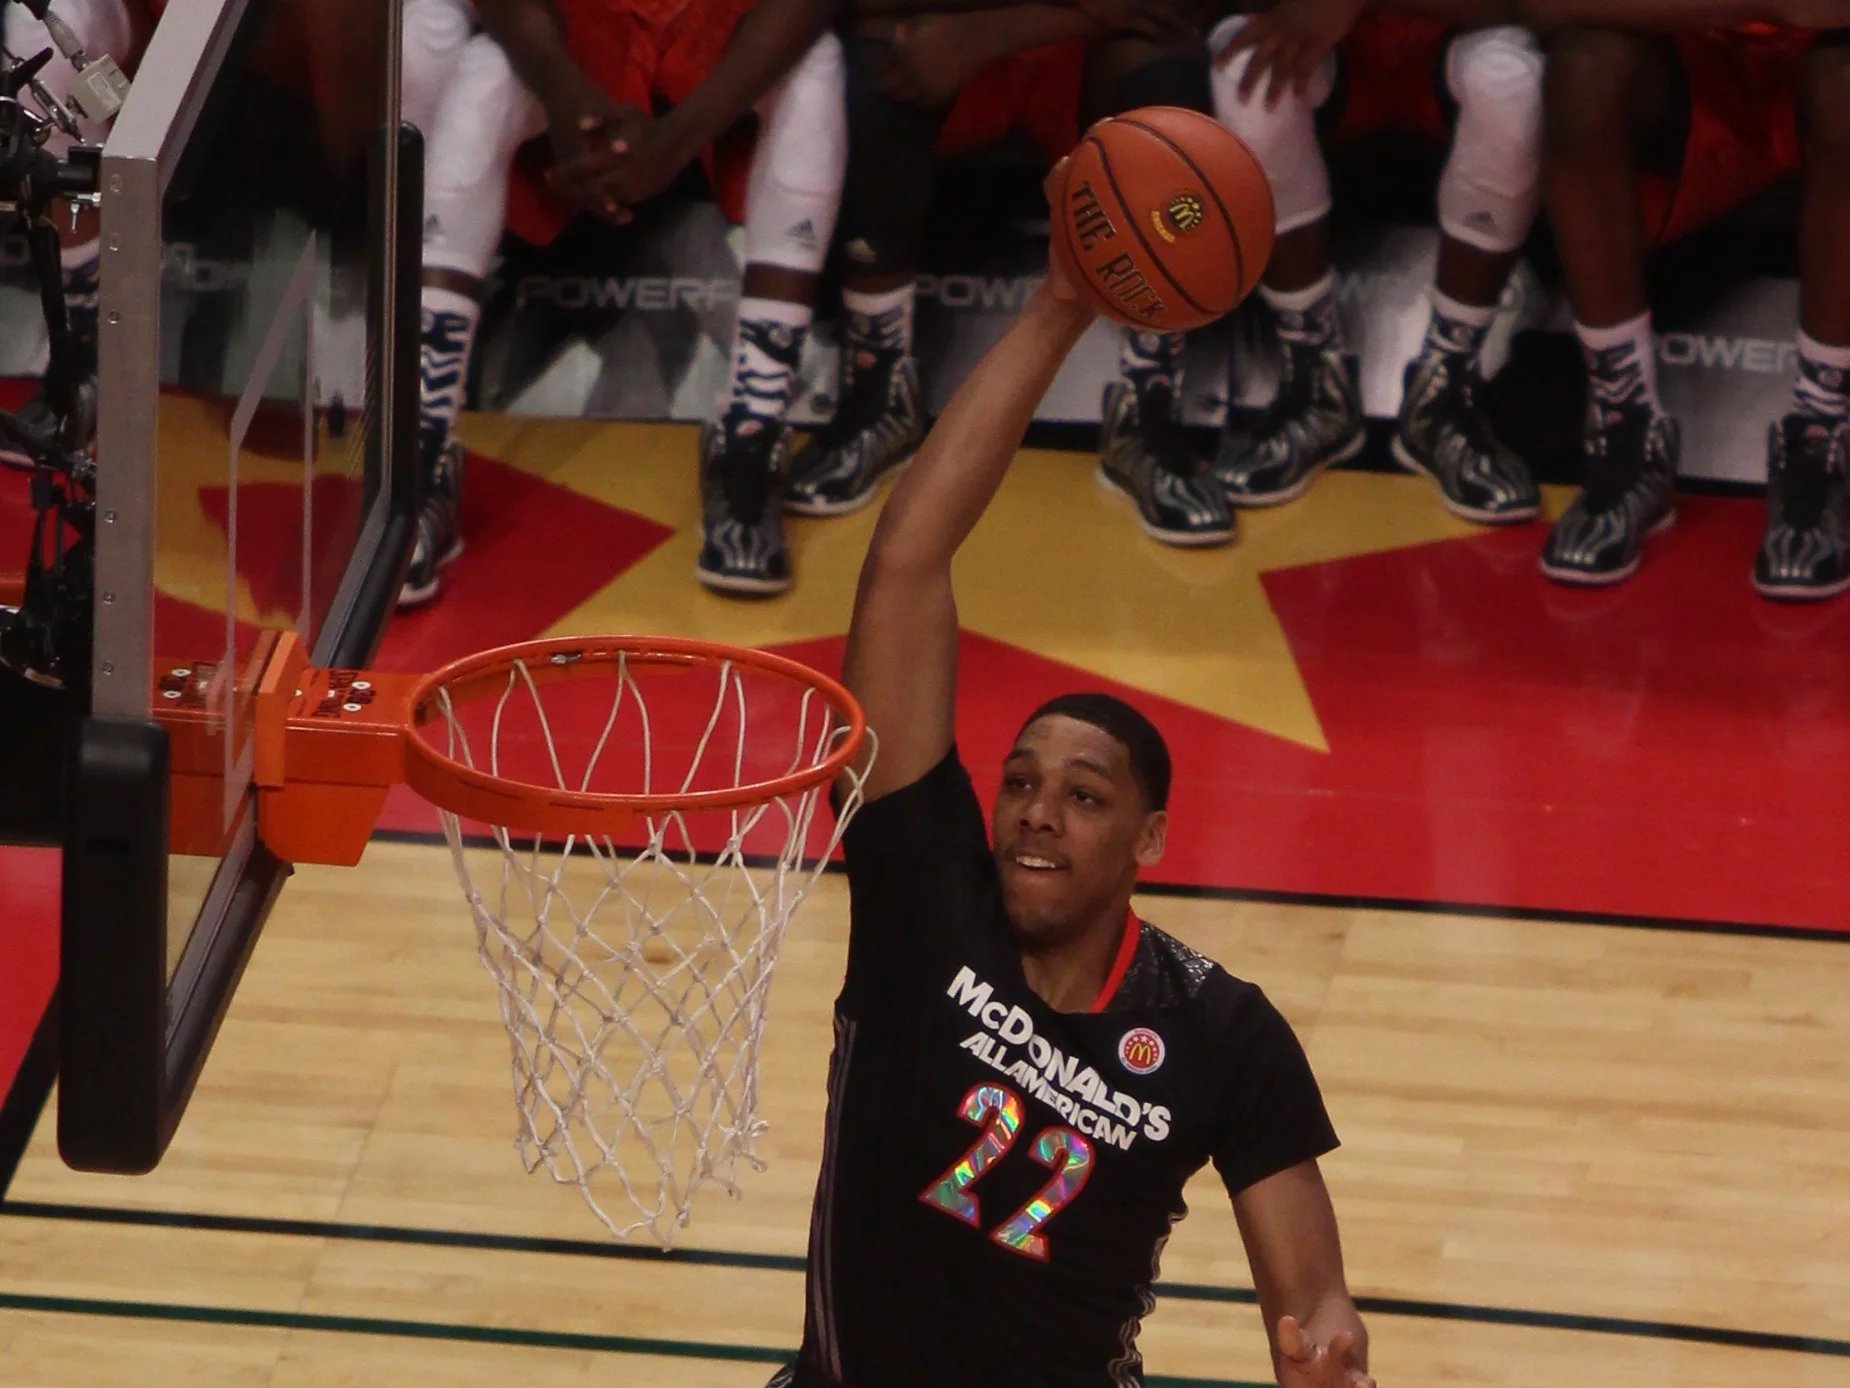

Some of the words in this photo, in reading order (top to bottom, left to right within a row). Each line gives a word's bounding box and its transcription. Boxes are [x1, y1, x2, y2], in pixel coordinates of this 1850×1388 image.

[1072, 181, 1117, 251] THE
[1097, 252, 1165, 317] ROCK
[918, 1081, 1096, 1263] 22
